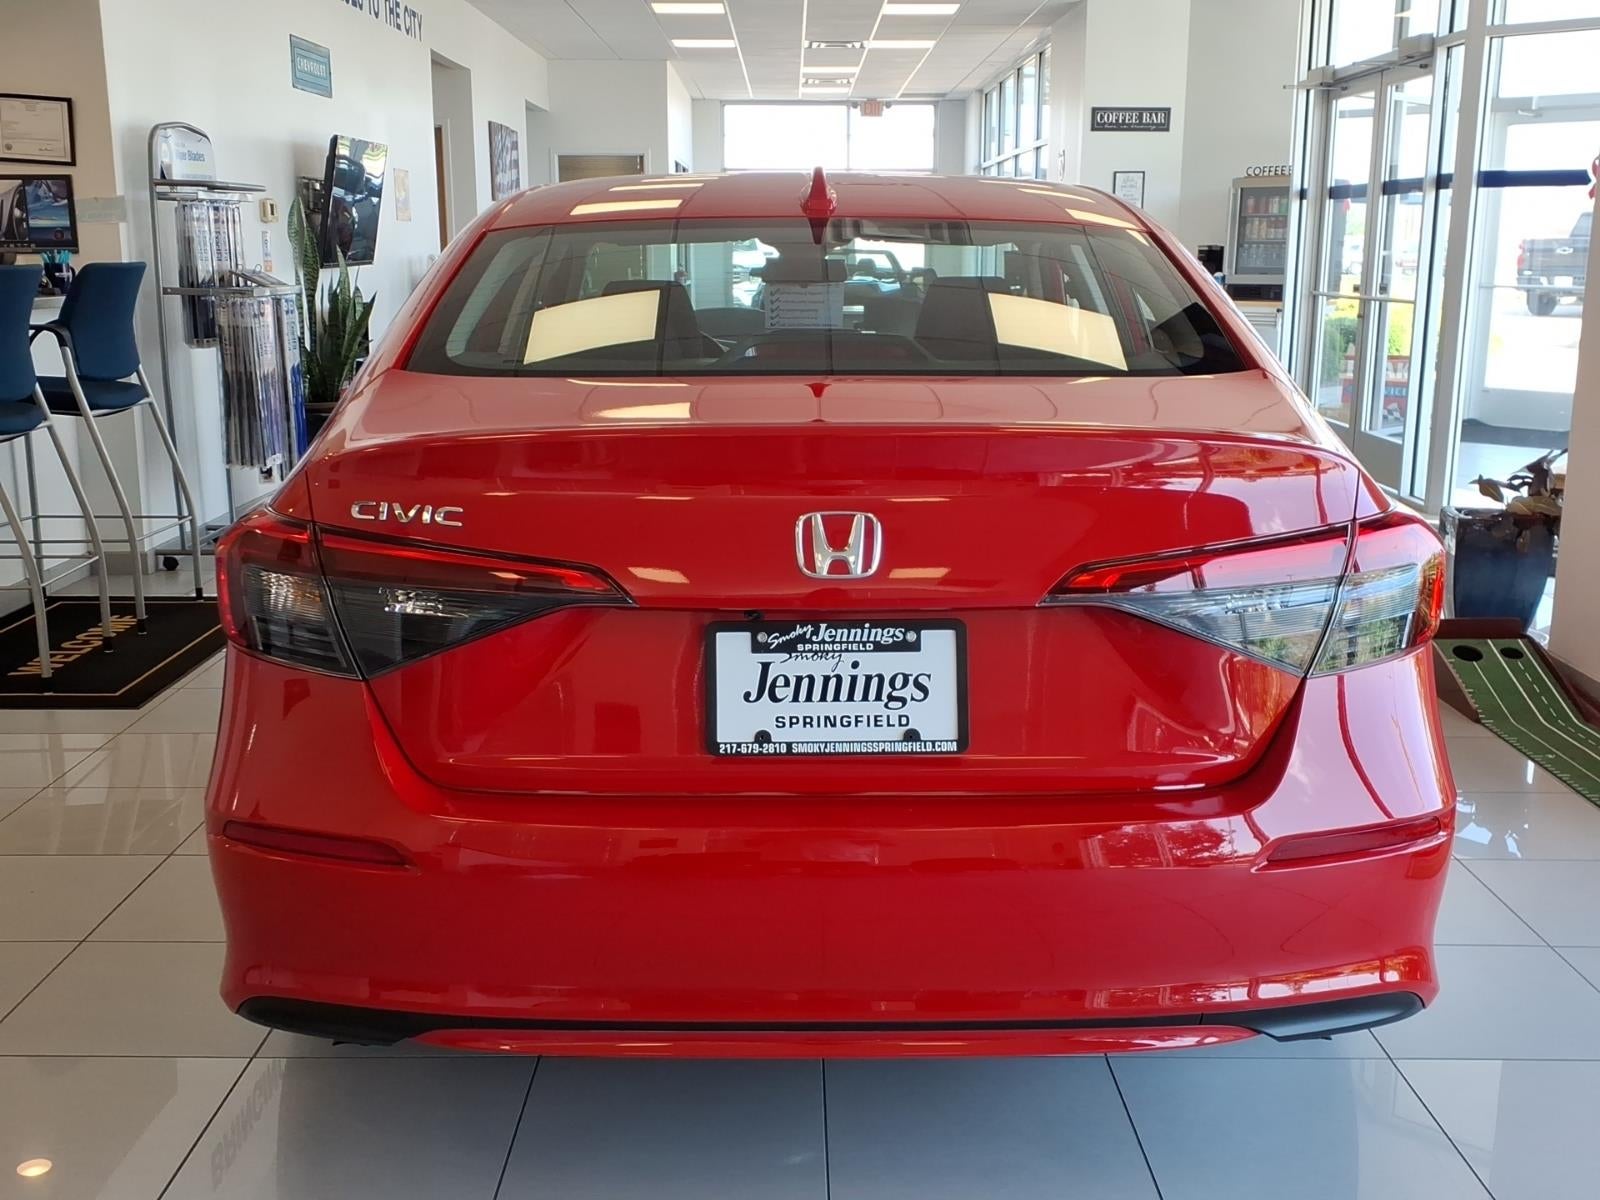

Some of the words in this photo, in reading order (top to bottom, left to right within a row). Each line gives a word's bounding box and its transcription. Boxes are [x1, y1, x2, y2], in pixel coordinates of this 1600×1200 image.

[384, 0, 402, 32] THE
[403, 5, 423, 42] CITY
[296, 54, 326, 77] CHEVROLET
[1097, 112, 1139, 124] COFFEE
[1142, 112, 1165, 124] BAR
[1246, 165, 1286, 176] COFFEE
[350, 501, 464, 527] CIVIC
[767, 624, 814, 649] Smoky
[812, 623, 905, 644] Jennings
[797, 643, 874, 651] SPRINGFIELD
[743, 660, 932, 710] Jennings
[775, 714, 910, 729] SPRINGFIELD
[719, 743, 787, 754] 217-679-2810
[792, 741, 958, 753] SMOKYJENNINGSSPRINGFIELD.COM
